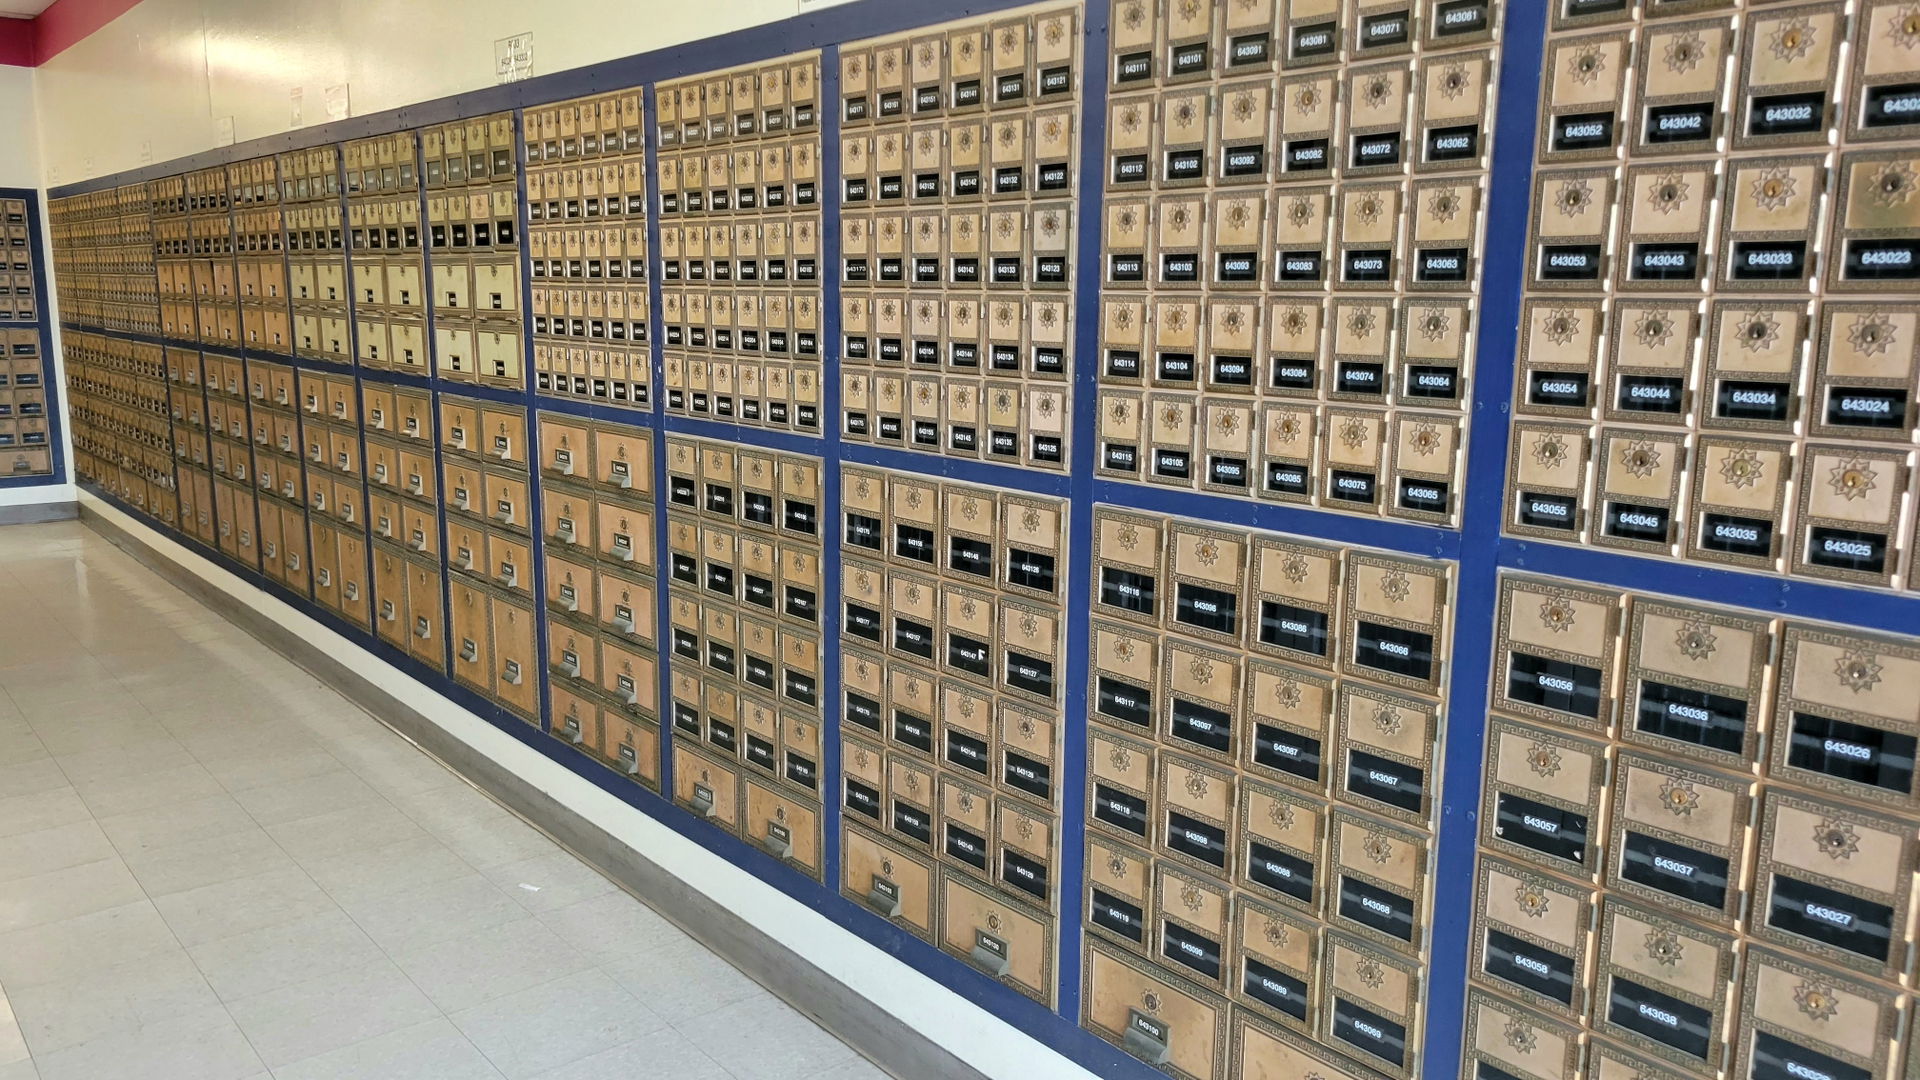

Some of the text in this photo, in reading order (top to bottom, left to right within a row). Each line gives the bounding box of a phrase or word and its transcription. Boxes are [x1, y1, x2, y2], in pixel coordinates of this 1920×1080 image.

[1371, 22, 1400, 36] 643071
[1179, 53, 1201, 65] 643101
[1125, 63, 1146, 74] 643111
[1766, 106, 1812, 121] 643032
[1660, 116, 1701, 130] 643042
[1566, 124, 1603, 137] 643052
[1361, 143, 1391, 155] 643072
[1437, 137, 1469, 149] 643062
[1230, 155, 1255, 166] 643092
[1295, 149, 1323, 160] 643082
[1121, 164, 1143, 173] 643112
[1174, 159, 1198, 170] 643102
[1426, 258, 1458, 269] 643063
[1550, 255, 1586, 266] 643053
[1644, 255, 1684, 266] 643043
[1748, 252, 1793, 265] 643033
[1862, 251, 1911, 264] 643023
[1117, 263, 1138, 271] 643113
[1170, 263, 1192, 271] 643103
[1225, 261, 1249, 270] 643093
[1286, 261, 1313, 271] 643083
[1354, 259, 1383, 269] 643073
[1114, 359, 1135, 367] 643114
[1165, 361, 1188, 370] 643104
[1220, 364, 1244, 373] 643094
[1281, 368, 1307, 377] 643084
[1346, 371, 1374, 381] 643074
[1419, 375, 1449, 386] 643064
[1542, 382, 1577, 393] 643054
[1631, 386, 1670, 399] 643044
[1733, 391, 1776, 404] 643034
[1842, 399, 1890, 412] 643024
[1112, 451, 1132, 461] 643115
[1161, 457, 1183, 467] 643105
[1216, 465, 1240, 477] 643095
[1276, 472, 1301, 483] 643085
[1339, 478, 1366, 490] 643075
[1408, 487, 1438, 500] 643065
[1532, 502, 1567, 516] 643055
[1620, 513, 1658, 527] 643045
[1715, 525, 1757, 541] 643035
[1824, 540, 1871, 556] 643025
[1380, 641, 1408, 656] 643066
[1539, 676, 1573, 691] 643056
[1115, 696, 1135, 707] 643117
[1669, 704, 1708, 721] 643036
[1189, 718, 1212, 730] 643097
[1273, 743, 1298, 756] 643087
[1824, 740, 1871, 759] 643026
[1370, 771, 1398, 785] 643067
[1110, 801, 1130, 815] 643118
[1524, 815, 1557, 833] 643057
[1654, 857, 1693, 876] 643037
[1362, 898, 1390, 915] 643068
[1806, 904, 1852, 925] 643027
[1515, 955, 1548, 974] 643058
[1263, 979, 1287, 995] 643089
[1640, 1004, 1677, 1026] 643038
[1139, 1018, 1159, 1036] 643100
[1354, 1020, 1382, 1039] 643069
